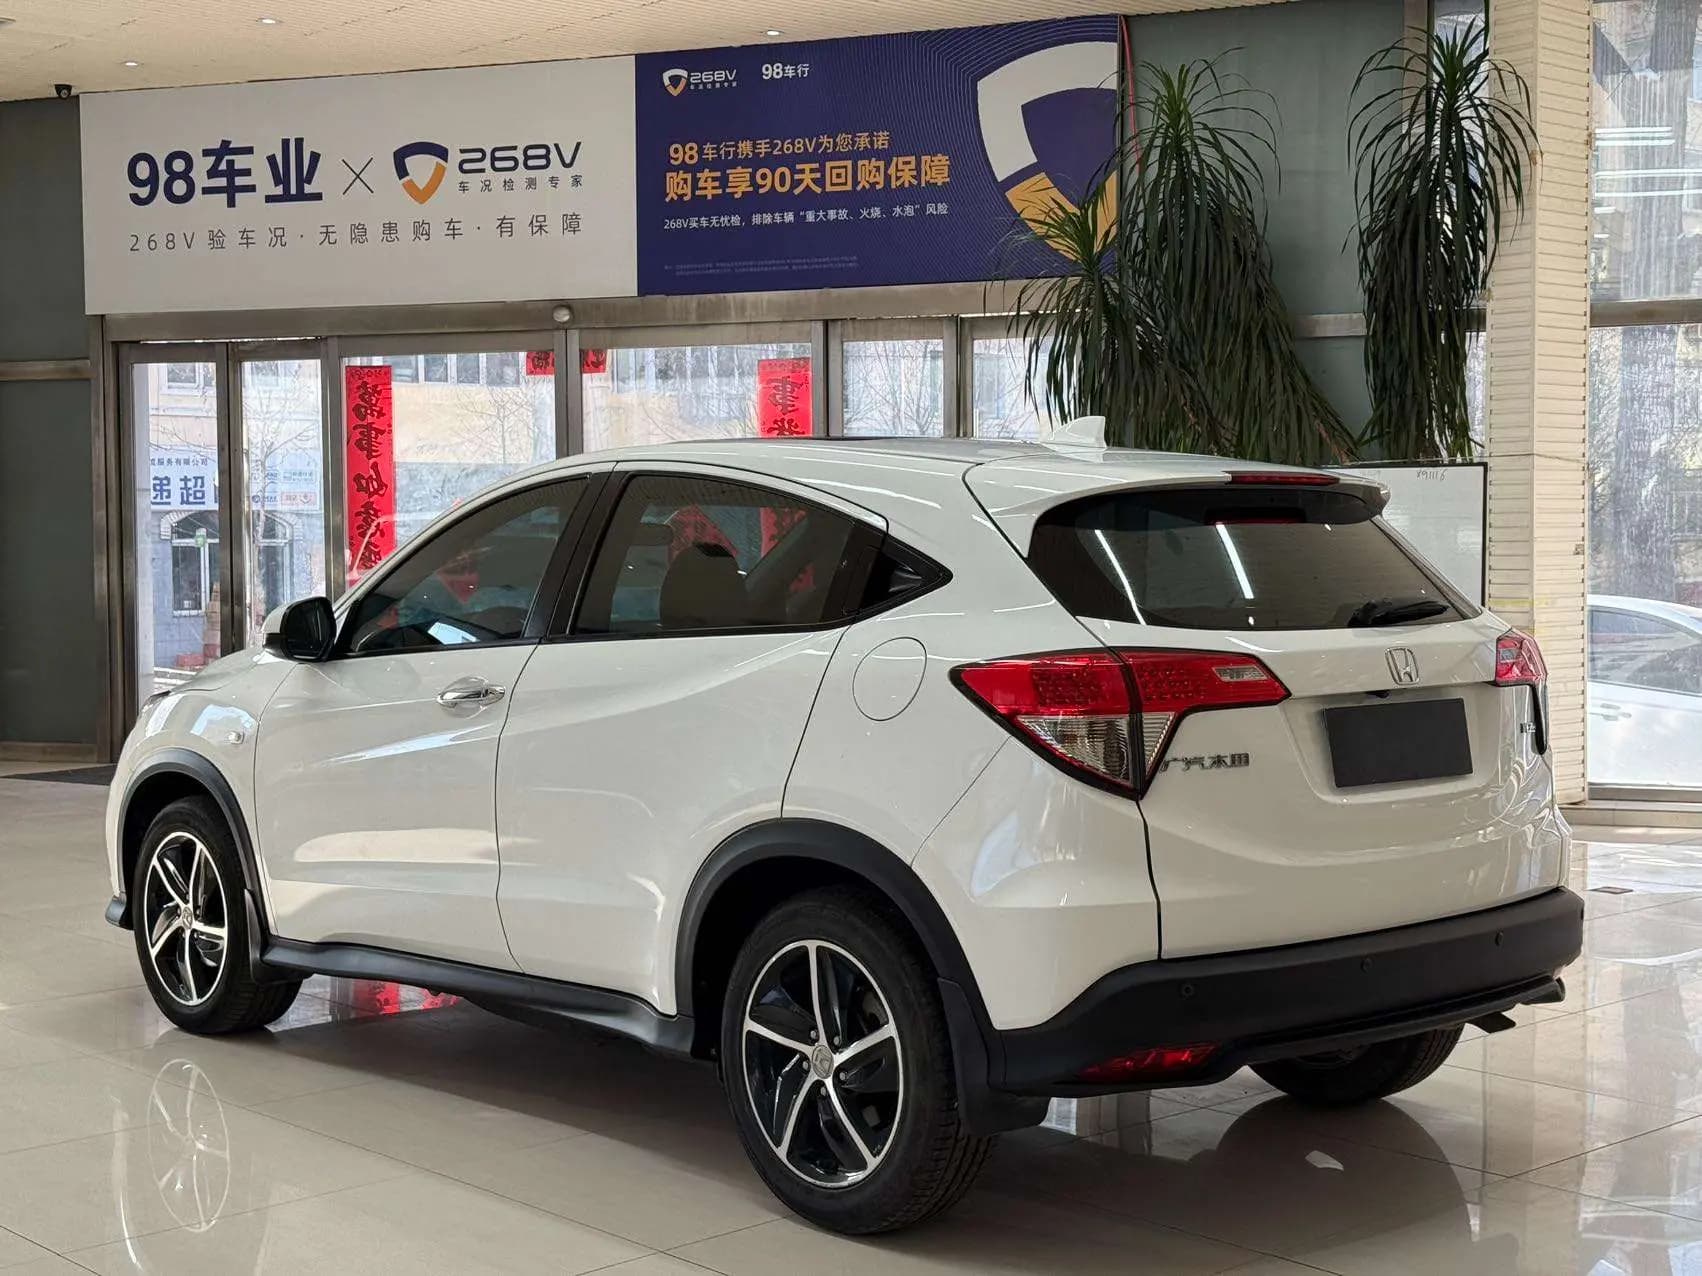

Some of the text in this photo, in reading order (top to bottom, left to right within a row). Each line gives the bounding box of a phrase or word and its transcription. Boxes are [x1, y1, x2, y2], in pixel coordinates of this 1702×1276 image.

[689, 69, 737, 83] 268V
[761, 62, 810, 81] 98车行
[458, 141, 582, 175] 268V
[669, 130, 891, 166] 98车行携手268V为您承诺
[127, 136, 323, 209] 98车业
[458, 174, 584, 194] 车况检测专家
[663, 153, 952, 203] 购车享90天回购保障
[150, 475, 218, 505] 递超
